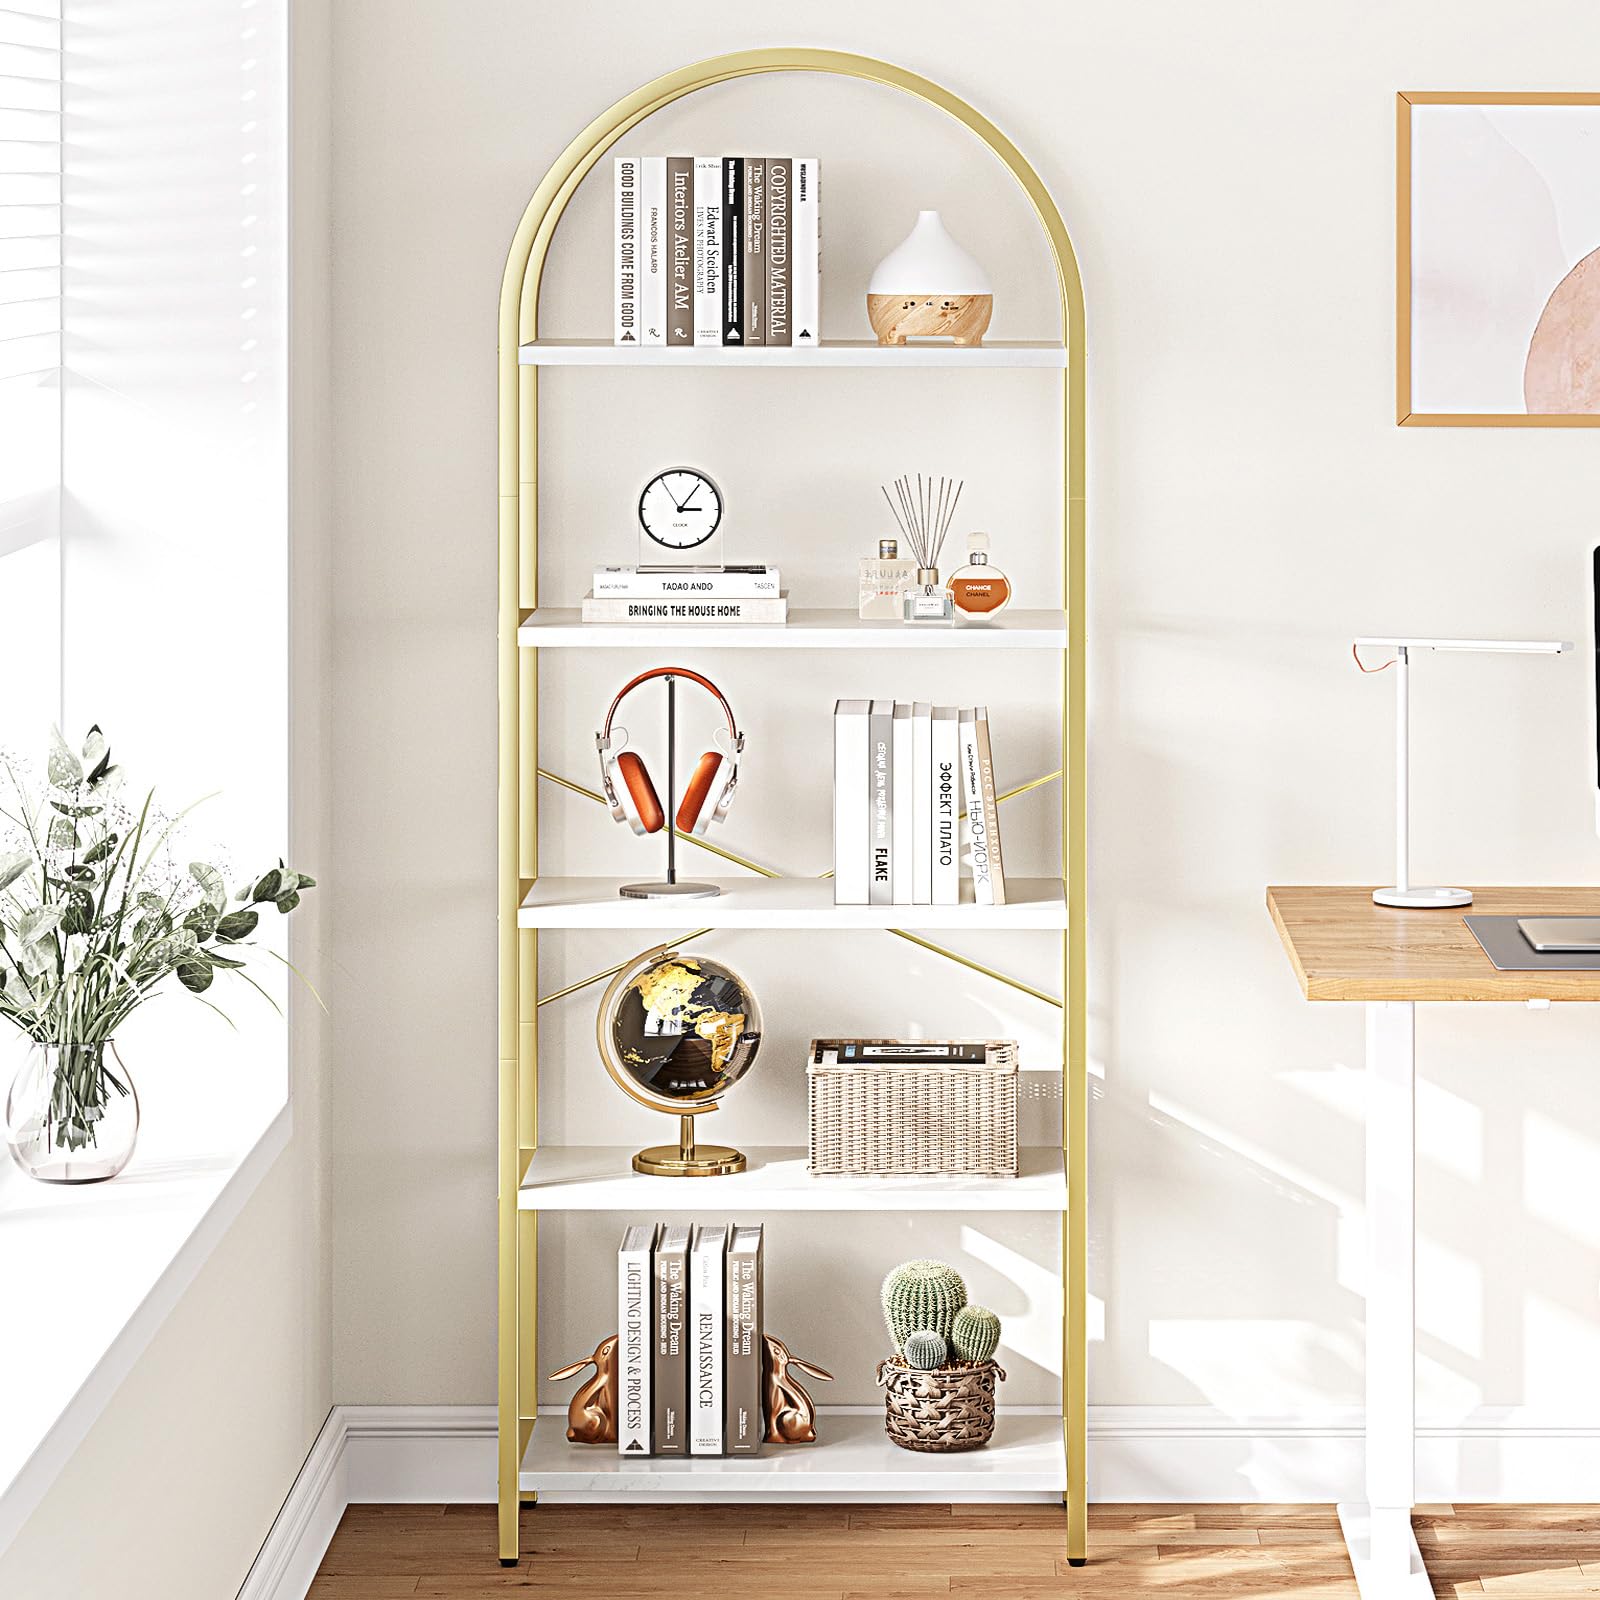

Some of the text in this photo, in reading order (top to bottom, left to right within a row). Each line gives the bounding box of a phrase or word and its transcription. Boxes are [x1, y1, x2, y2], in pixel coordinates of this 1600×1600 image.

[621, 163, 634, 327] GOOD BUILDINGS COME FROM GOOD
[674, 172, 689, 310] Interiors Atelier AM
[696, 207, 704, 228] LIVES
[696, 229, 704, 237] IN
[707, 207, 719, 294] Edward Steichen
[752, 165, 762, 253] The Waking Dream
[770, 165, 786, 336] COPYRIGHTED MATERIAL
[650, 245, 658, 273] HALARD
[628, 605, 741, 617] BRINGING THE HOUSE HOME
[662, 582, 713, 591] TADAO ANDO
[939, 763, 952, 866] ЭФФЕКТ ПЛАТО
[969, 800, 989, 884] НЬЮ-ЙОРК
[982, 759, 1000, 871] РОСС ЭЛЛЕНХОРН
[875, 848, 888, 881] FLAKE
[627, 1262, 641, 1429] LIGHTING DESIGN & PROCESS
[668, 1260, 681, 1355] The Waking Dream
[740, 1260, 754, 1355] The Waking Dream
[699, 1313, 713, 1409] RENAISSANCE
